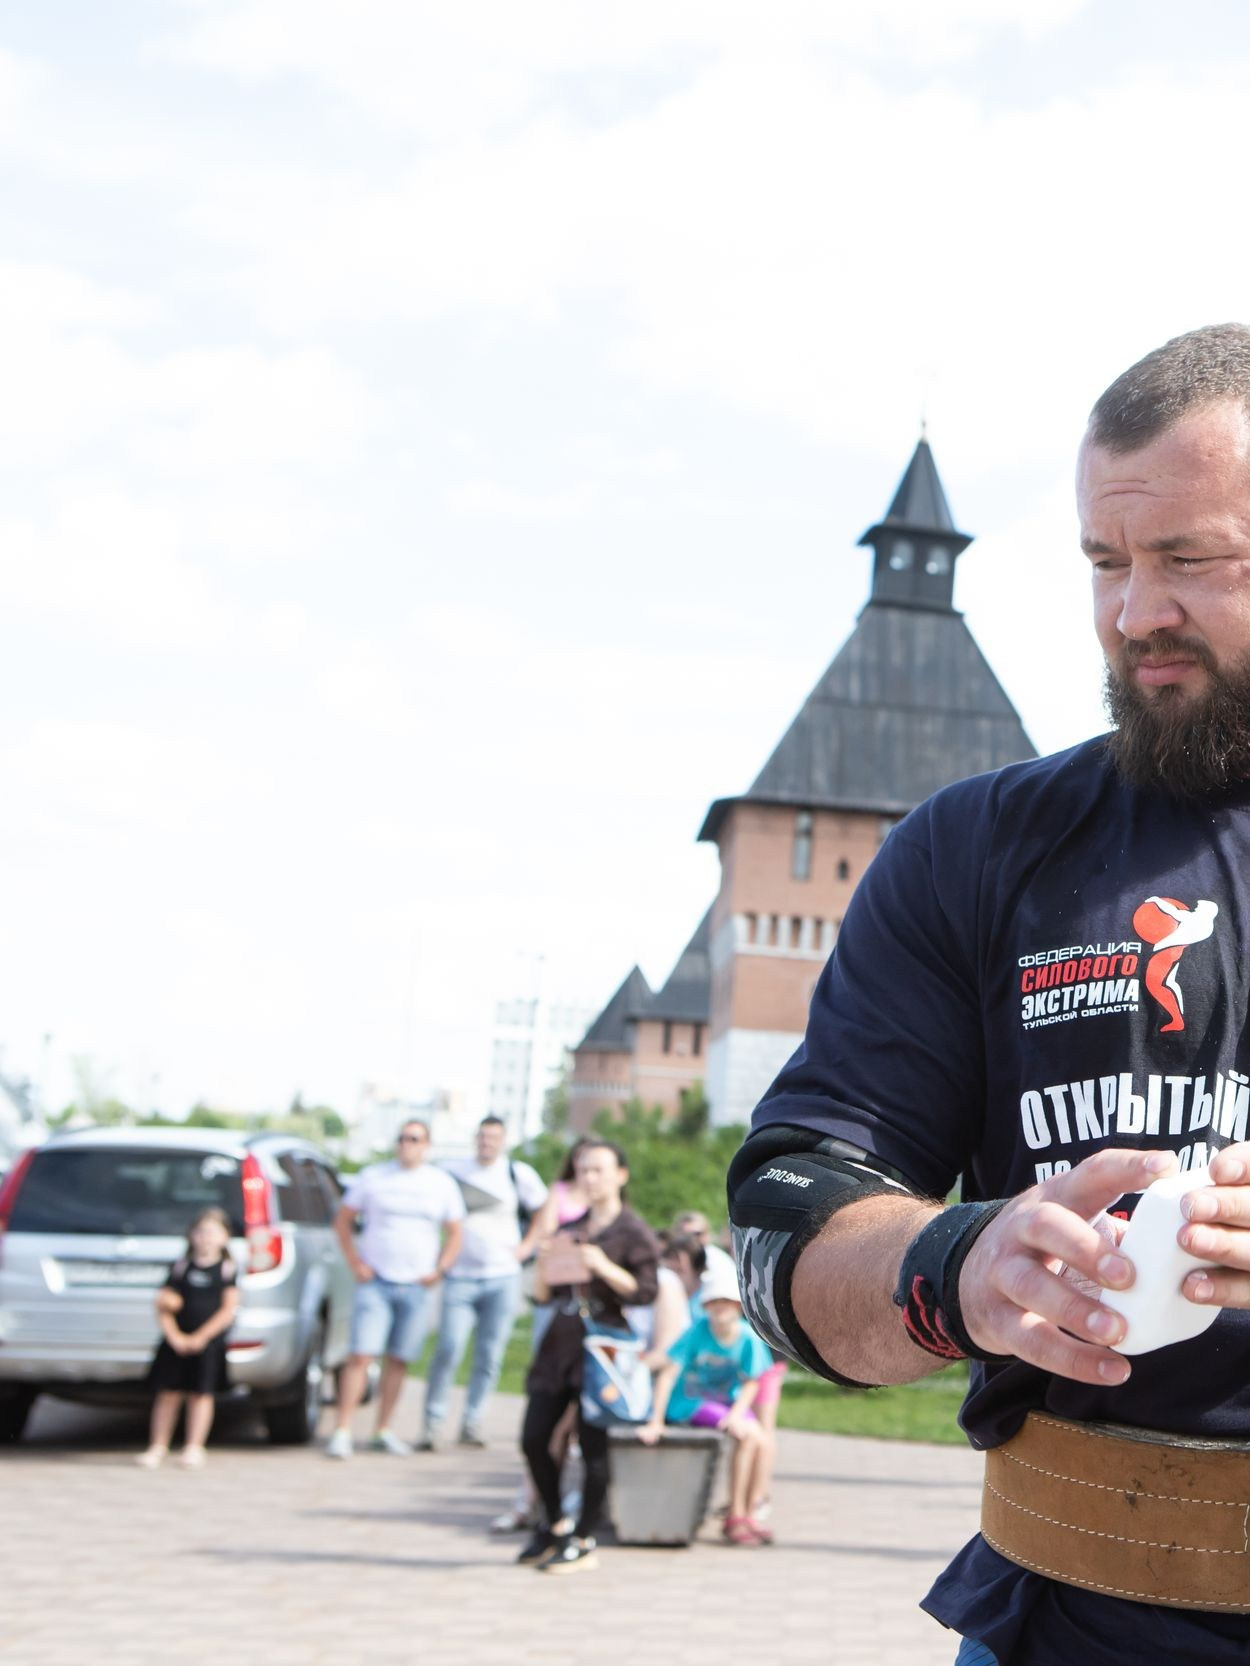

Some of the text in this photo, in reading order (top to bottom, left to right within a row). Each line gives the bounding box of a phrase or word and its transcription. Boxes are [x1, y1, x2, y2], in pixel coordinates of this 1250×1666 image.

[1018, 942, 1142, 967] ФЕДЕРАЦИЯ
[1021, 954, 1139, 992] СИЛОВОГО
[1021, 979, 1140, 1020] ЭКСТРИМА
[1022, 1004, 1139, 1030] ТУЛЬСКОЙ ОБЛАСТИ
[1020, 1070, 1250, 1150] ОТКРЫТЫЙ
